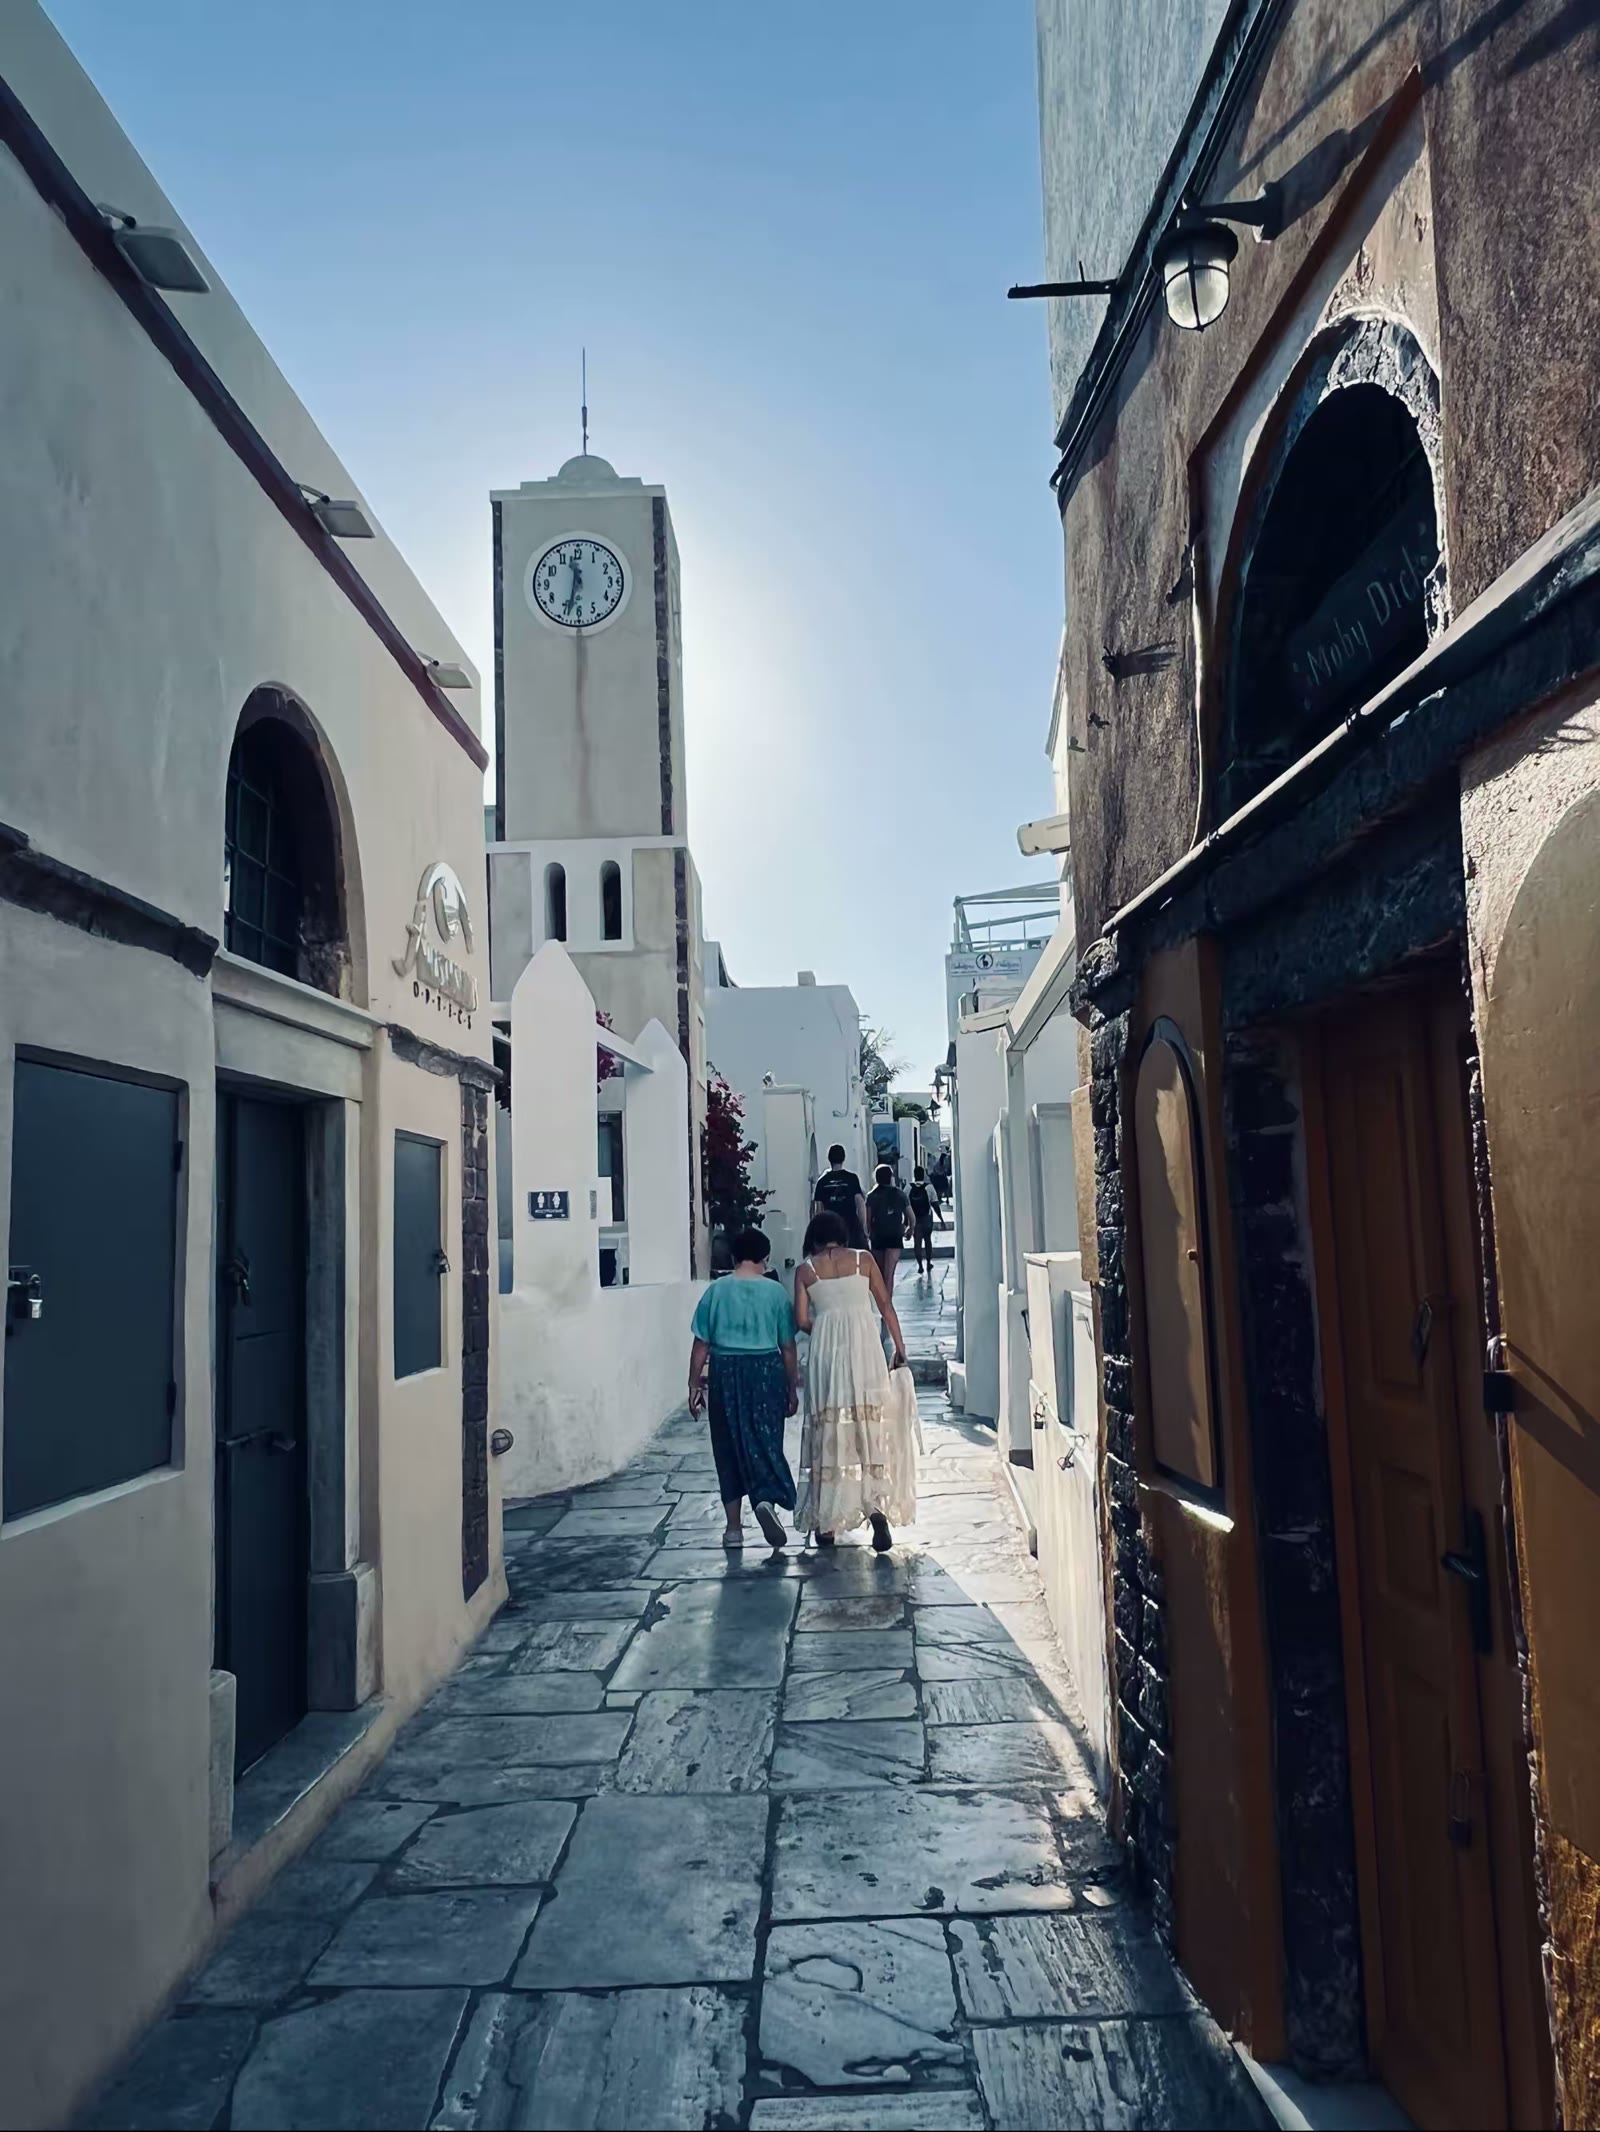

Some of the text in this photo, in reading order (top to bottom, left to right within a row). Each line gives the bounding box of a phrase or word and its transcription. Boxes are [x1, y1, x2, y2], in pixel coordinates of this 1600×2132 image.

[559, 553, 566, 565] 11
[573, 548, 582, 560] 12
[548, 564, 557, 577] 10
[602, 562, 608, 575] 2
[543, 579, 550, 591] 9
[607, 576, 613, 588] 3
[549, 591, 555, 604] 8
[603, 589, 609, 602] 4
[576, 605, 582, 618] 6
[590, 602, 596, 614] 5
[1306, 617, 1373, 686] Moby
